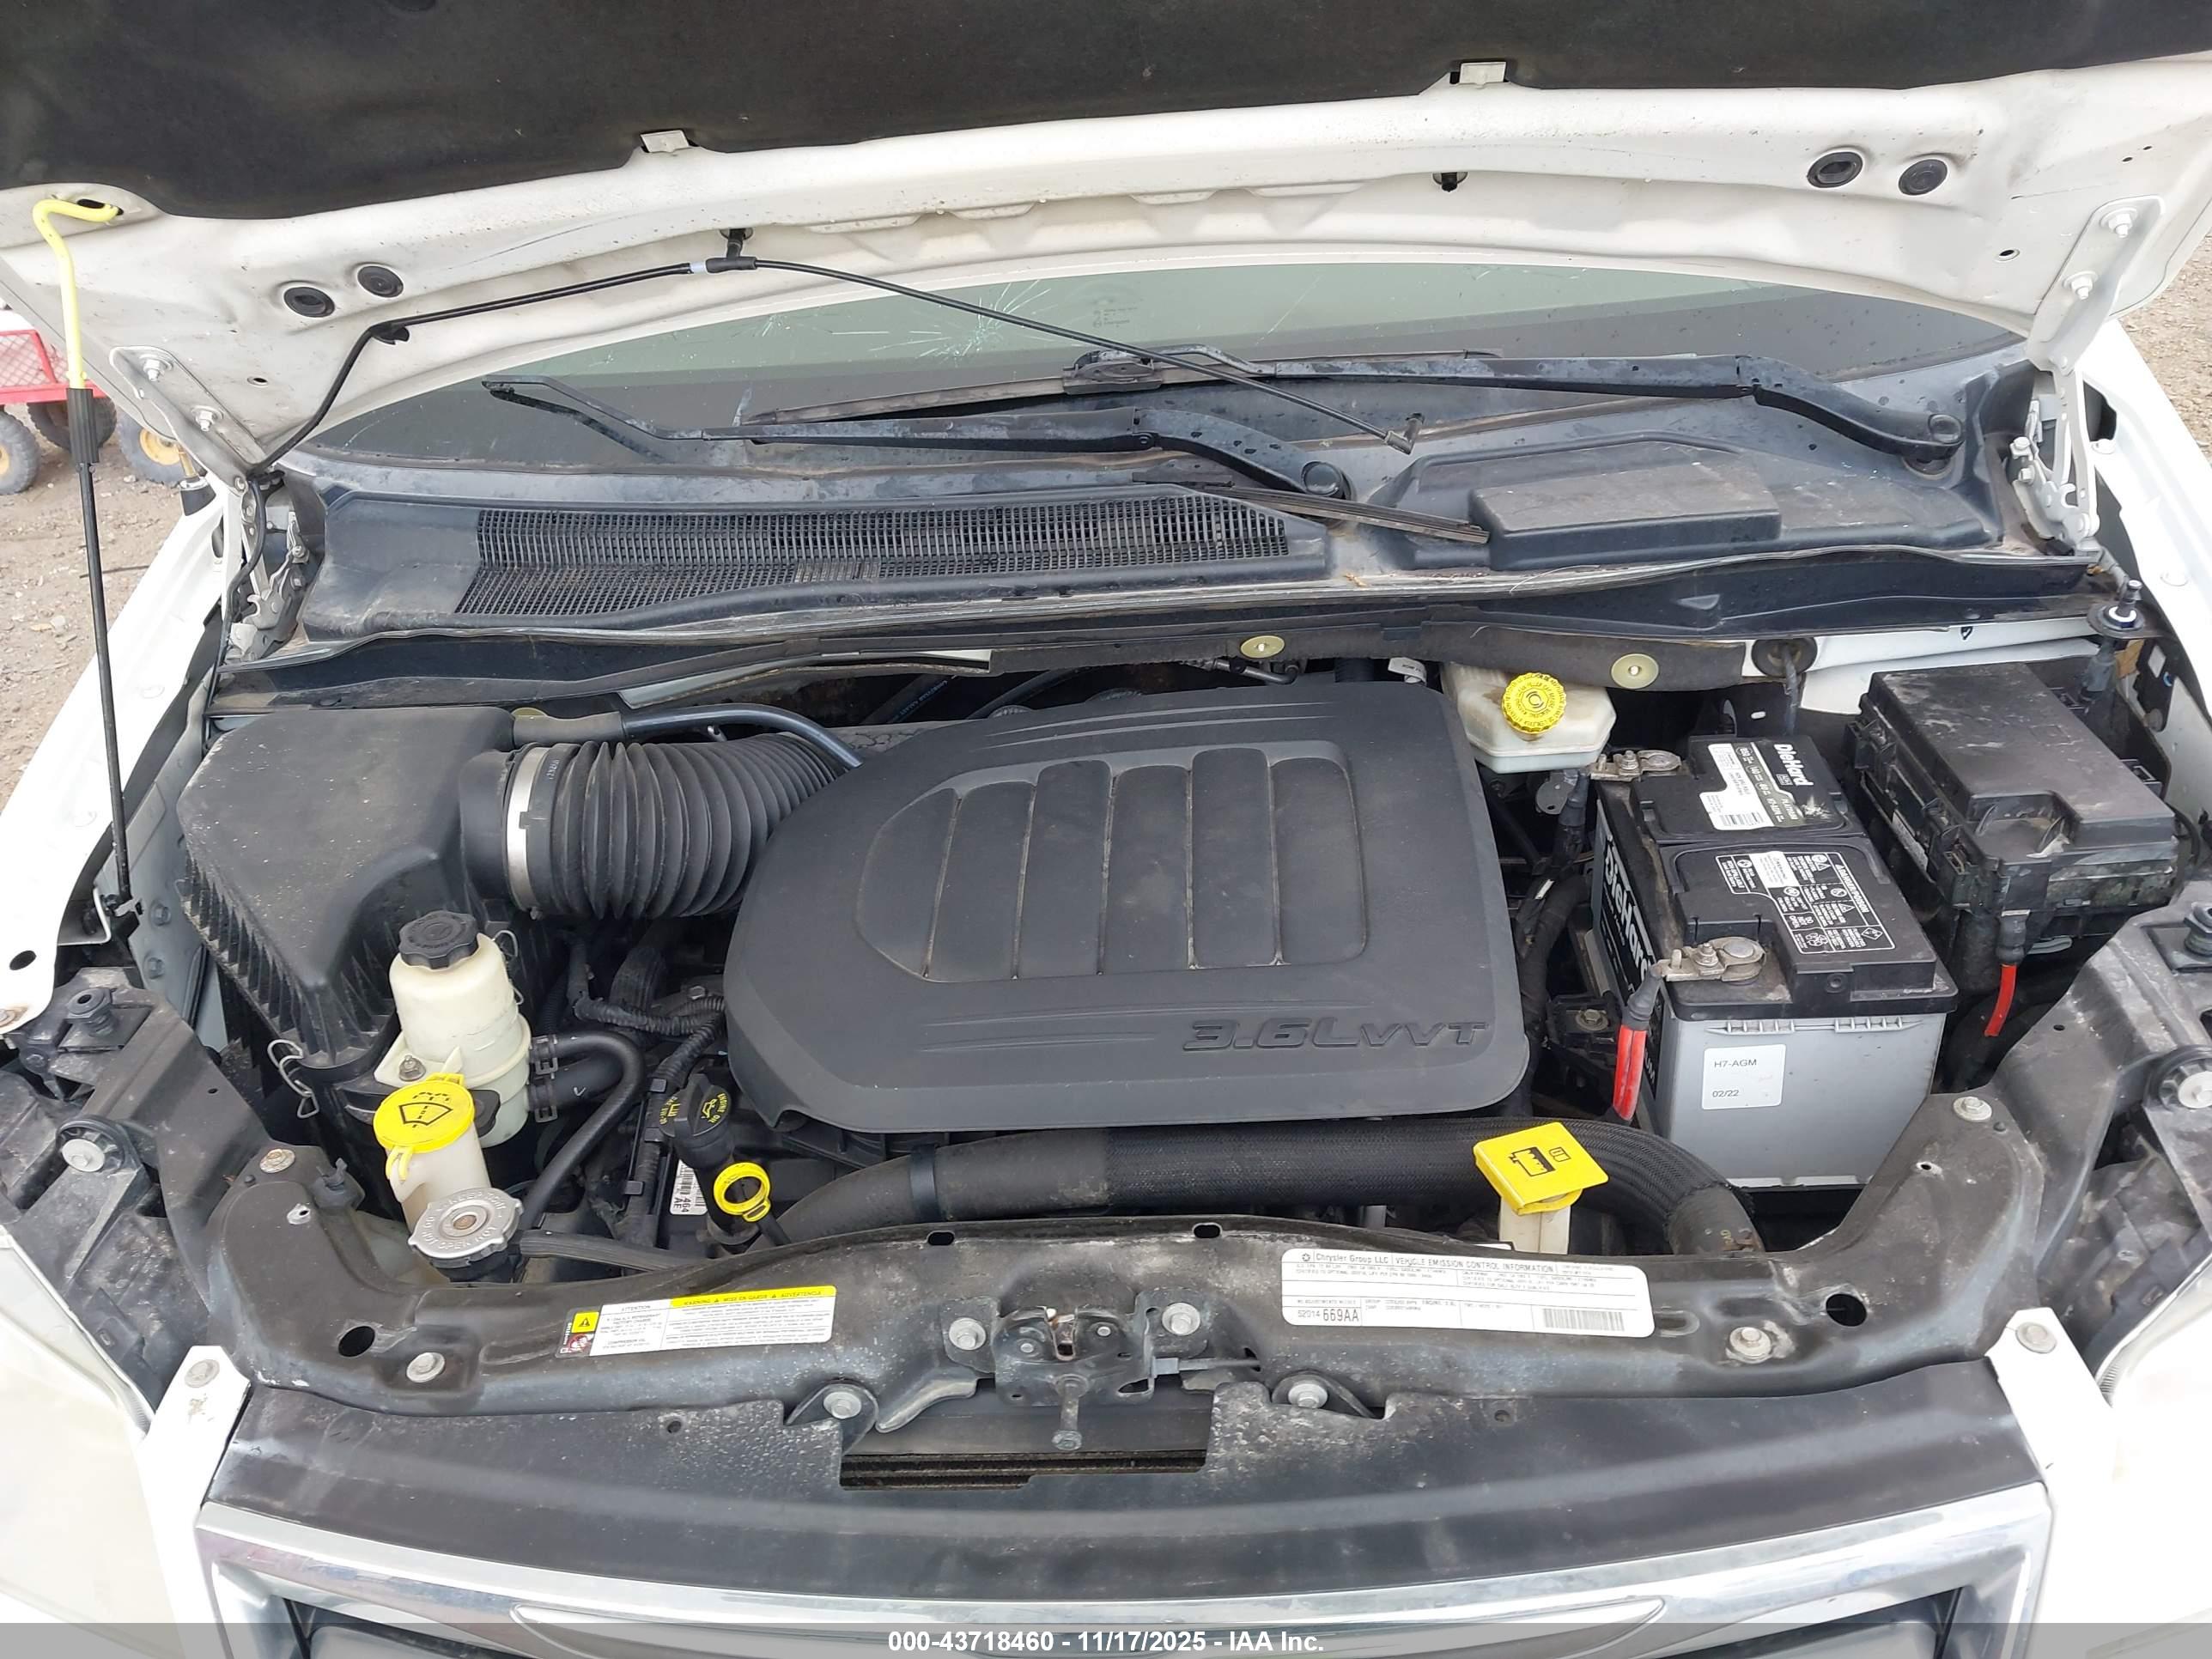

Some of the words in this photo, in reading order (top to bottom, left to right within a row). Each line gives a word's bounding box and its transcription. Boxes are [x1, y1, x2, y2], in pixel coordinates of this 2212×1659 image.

[1773, 743, 1814, 787] DieHard
[1714, 1059, 1757, 1067] H7-AGM
[1316, 1253, 1346, 1262] Chrysler
[1349, 1255, 1372, 1263] Group
[1395, 1257, 1425, 1266] VEHICLE
[1428, 1259, 1463, 1267] EMISSION
[1466, 1261, 1499, 1269] CONTROL
[1503, 1263, 1553, 1272] INFORMATION
[1322, 1308, 1359, 1322] 669AA
